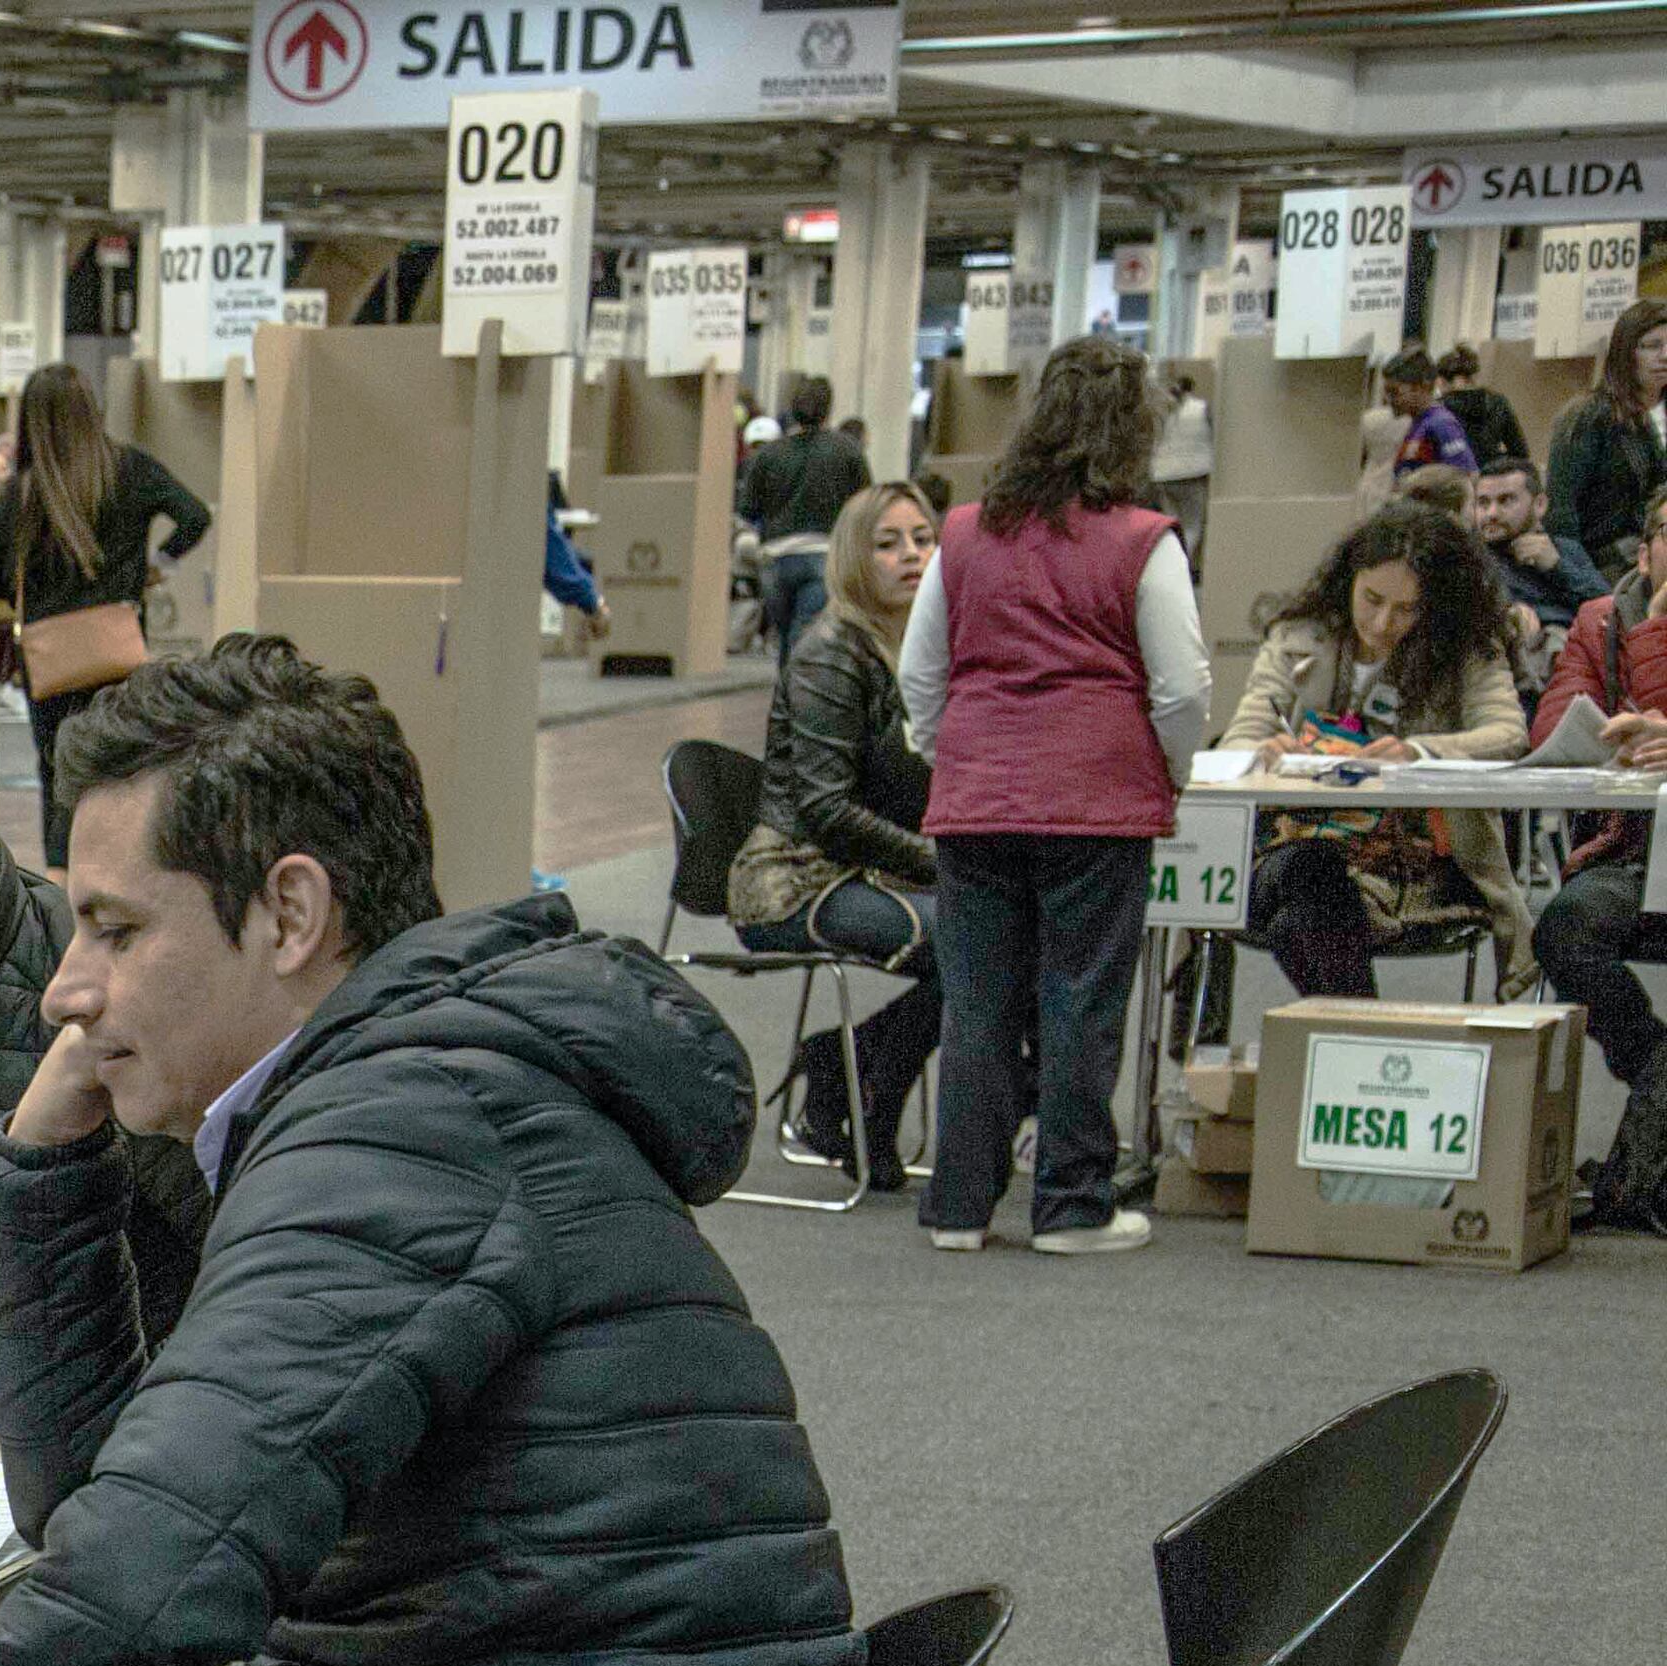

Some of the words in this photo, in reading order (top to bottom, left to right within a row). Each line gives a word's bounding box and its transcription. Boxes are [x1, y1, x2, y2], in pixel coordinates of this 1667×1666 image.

[398, 4, 693, 78] SALIDA
[458, 119, 565, 184] 020
[1482, 161, 1643, 201] SALIDA
[456, 217, 560, 238] 52.002.487
[1283, 210, 1339, 249] 028
[1351, 205, 1404, 246] 028
[160, 245, 203, 283] 027
[213, 243, 276, 281] 027
[1543, 242, 1580, 273] 036
[1588, 238, 1636, 270] 036
[454, 264, 558, 286] 52.004.069
[695, 263, 742, 294] 035
[1200, 866, 1236, 903] 12
[1312, 1104, 1408, 1150] MESA
[1430, 1113, 1468, 1154] 12
